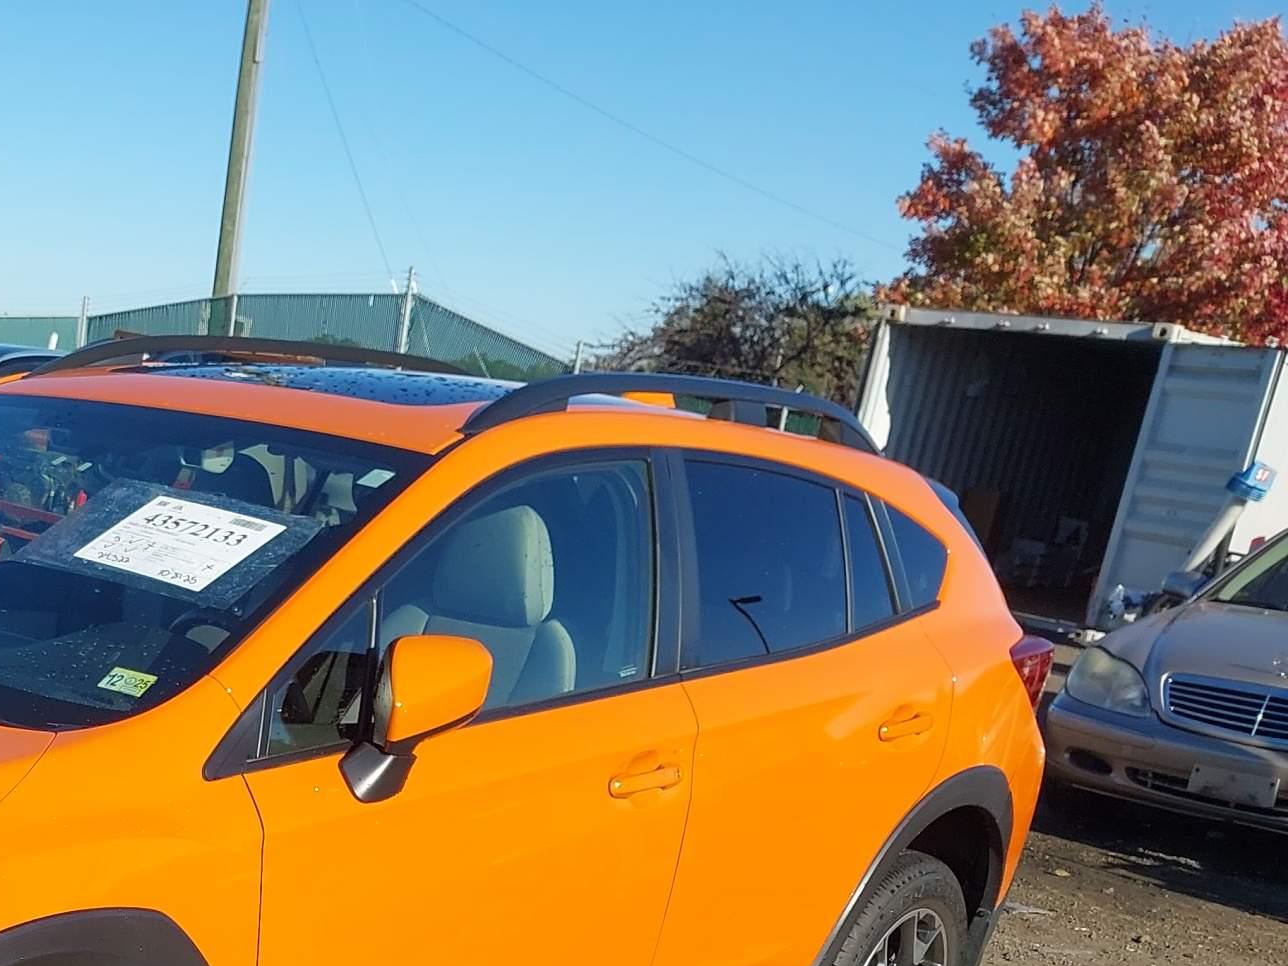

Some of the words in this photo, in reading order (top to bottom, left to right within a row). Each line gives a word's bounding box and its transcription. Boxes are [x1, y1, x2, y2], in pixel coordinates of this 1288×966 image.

[143, 513, 248, 546] 43572133
[106, 673, 125, 687] 12
[134, 678, 151, 689] 25
